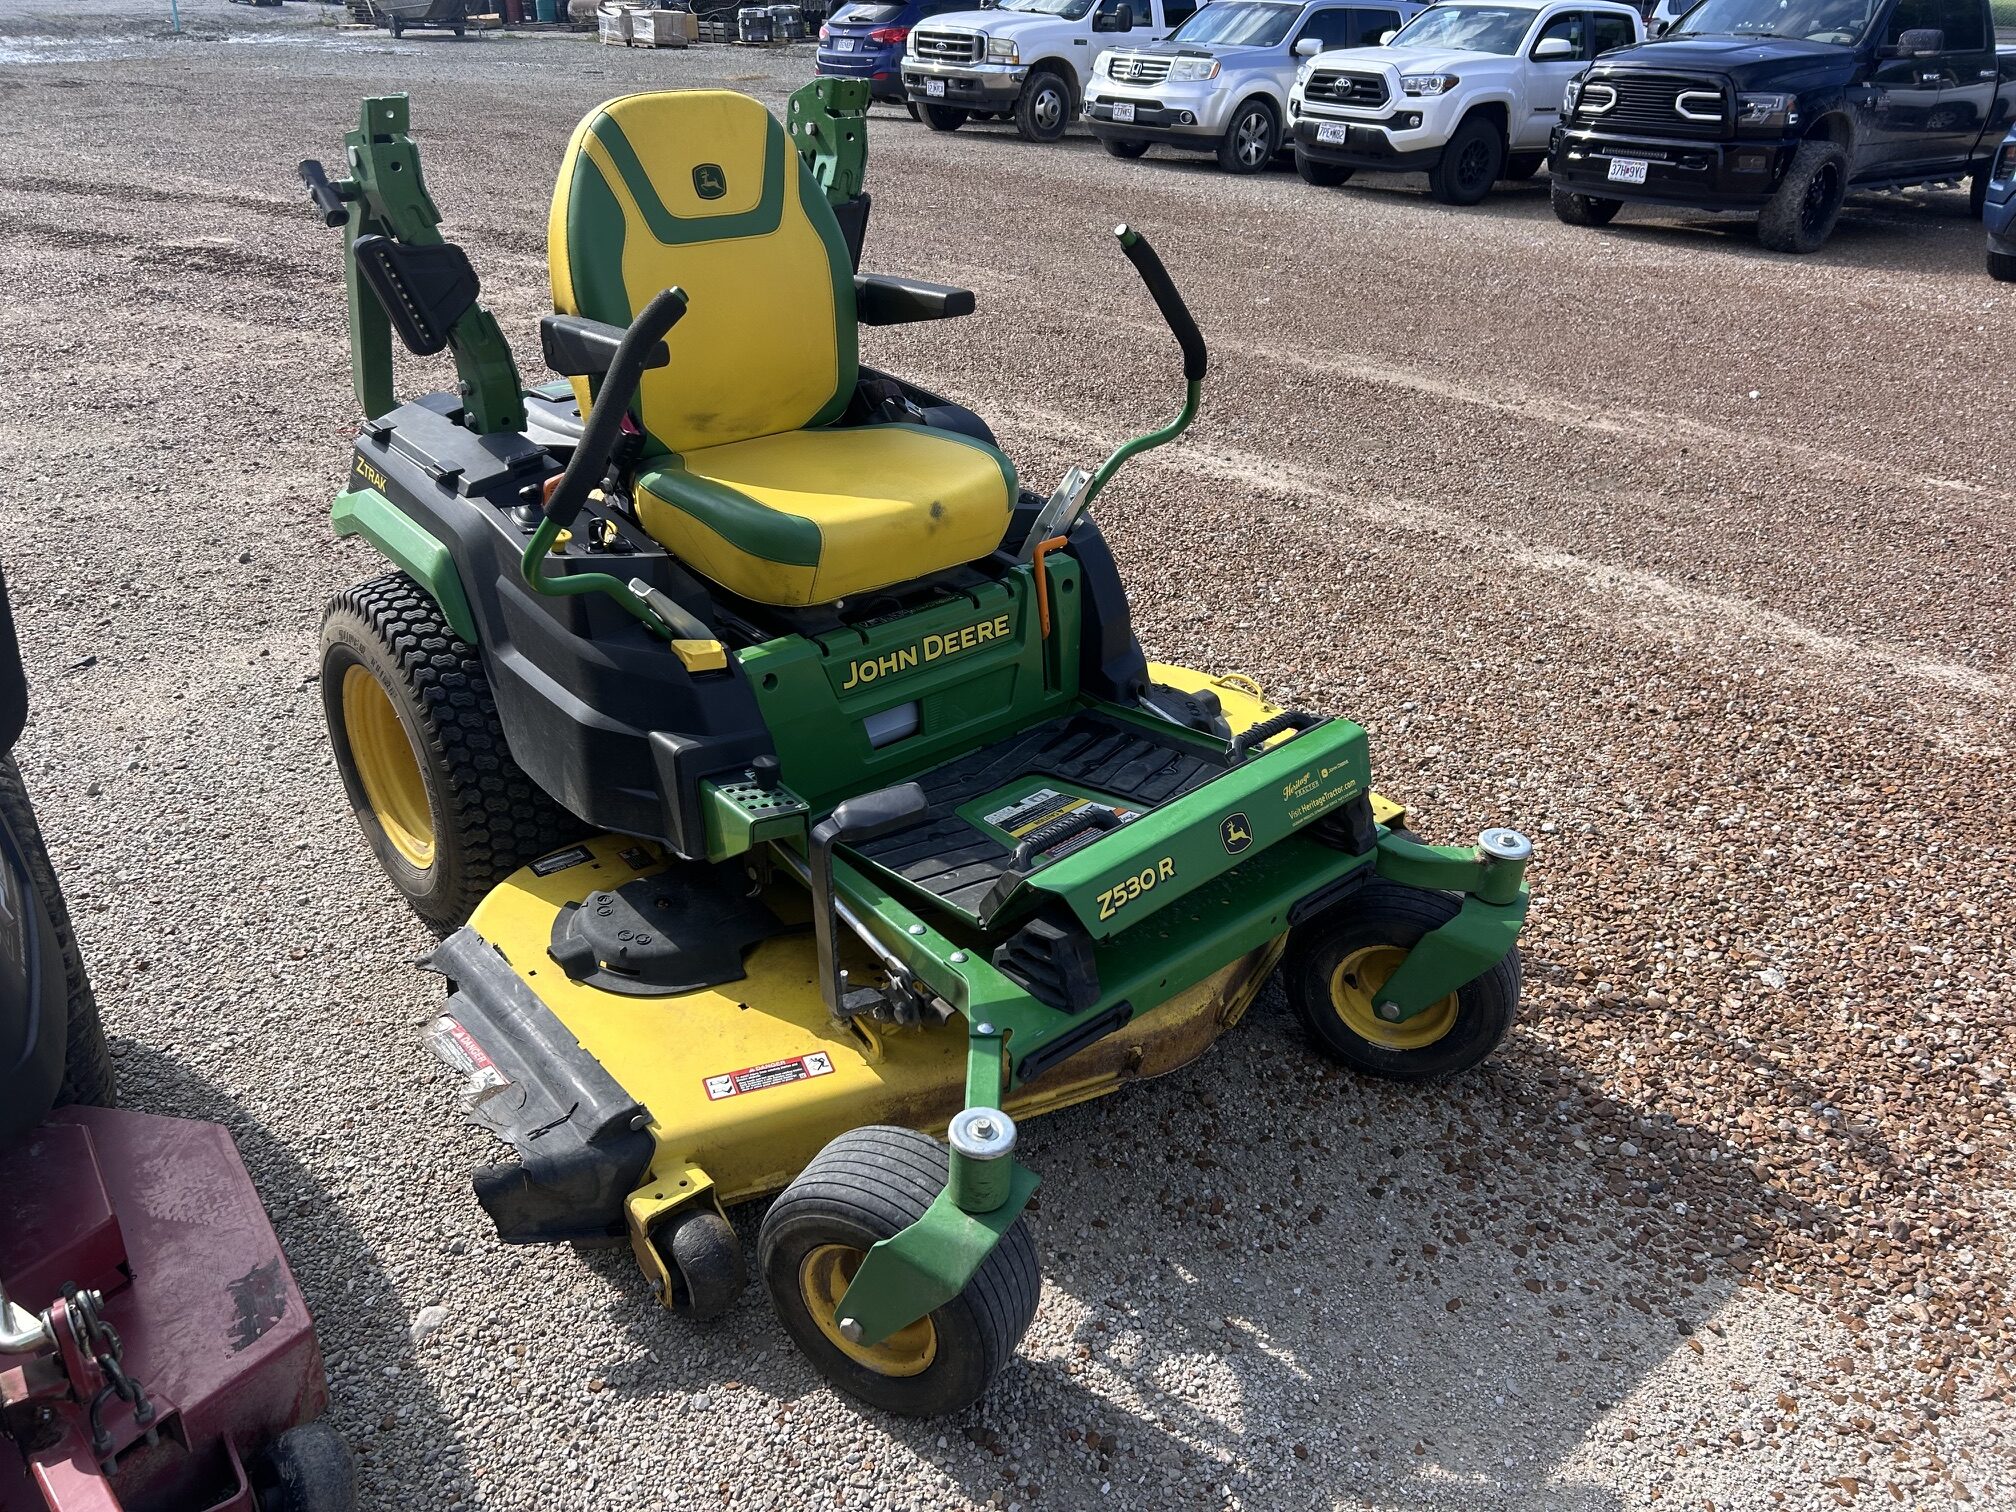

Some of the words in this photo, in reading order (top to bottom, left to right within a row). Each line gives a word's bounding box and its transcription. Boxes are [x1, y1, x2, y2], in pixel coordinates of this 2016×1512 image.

[356, 455, 387, 493] ZTRAK
[843, 645, 918, 690] JOHN
[923, 614, 1010, 662] DEERE
[1282, 772, 1310, 801] Heritage
[1288, 808, 1302, 819] Visit
[1301, 779, 1357, 812] HeritageTractor.com
[1295, 780, 1320, 799] TRACTOR
[1096, 867, 1156, 921] Z530
[1158, 856, 1175, 881] R
[461, 1036, 487, 1063] DANGER
[755, 1060, 786, 1071] DANGER
